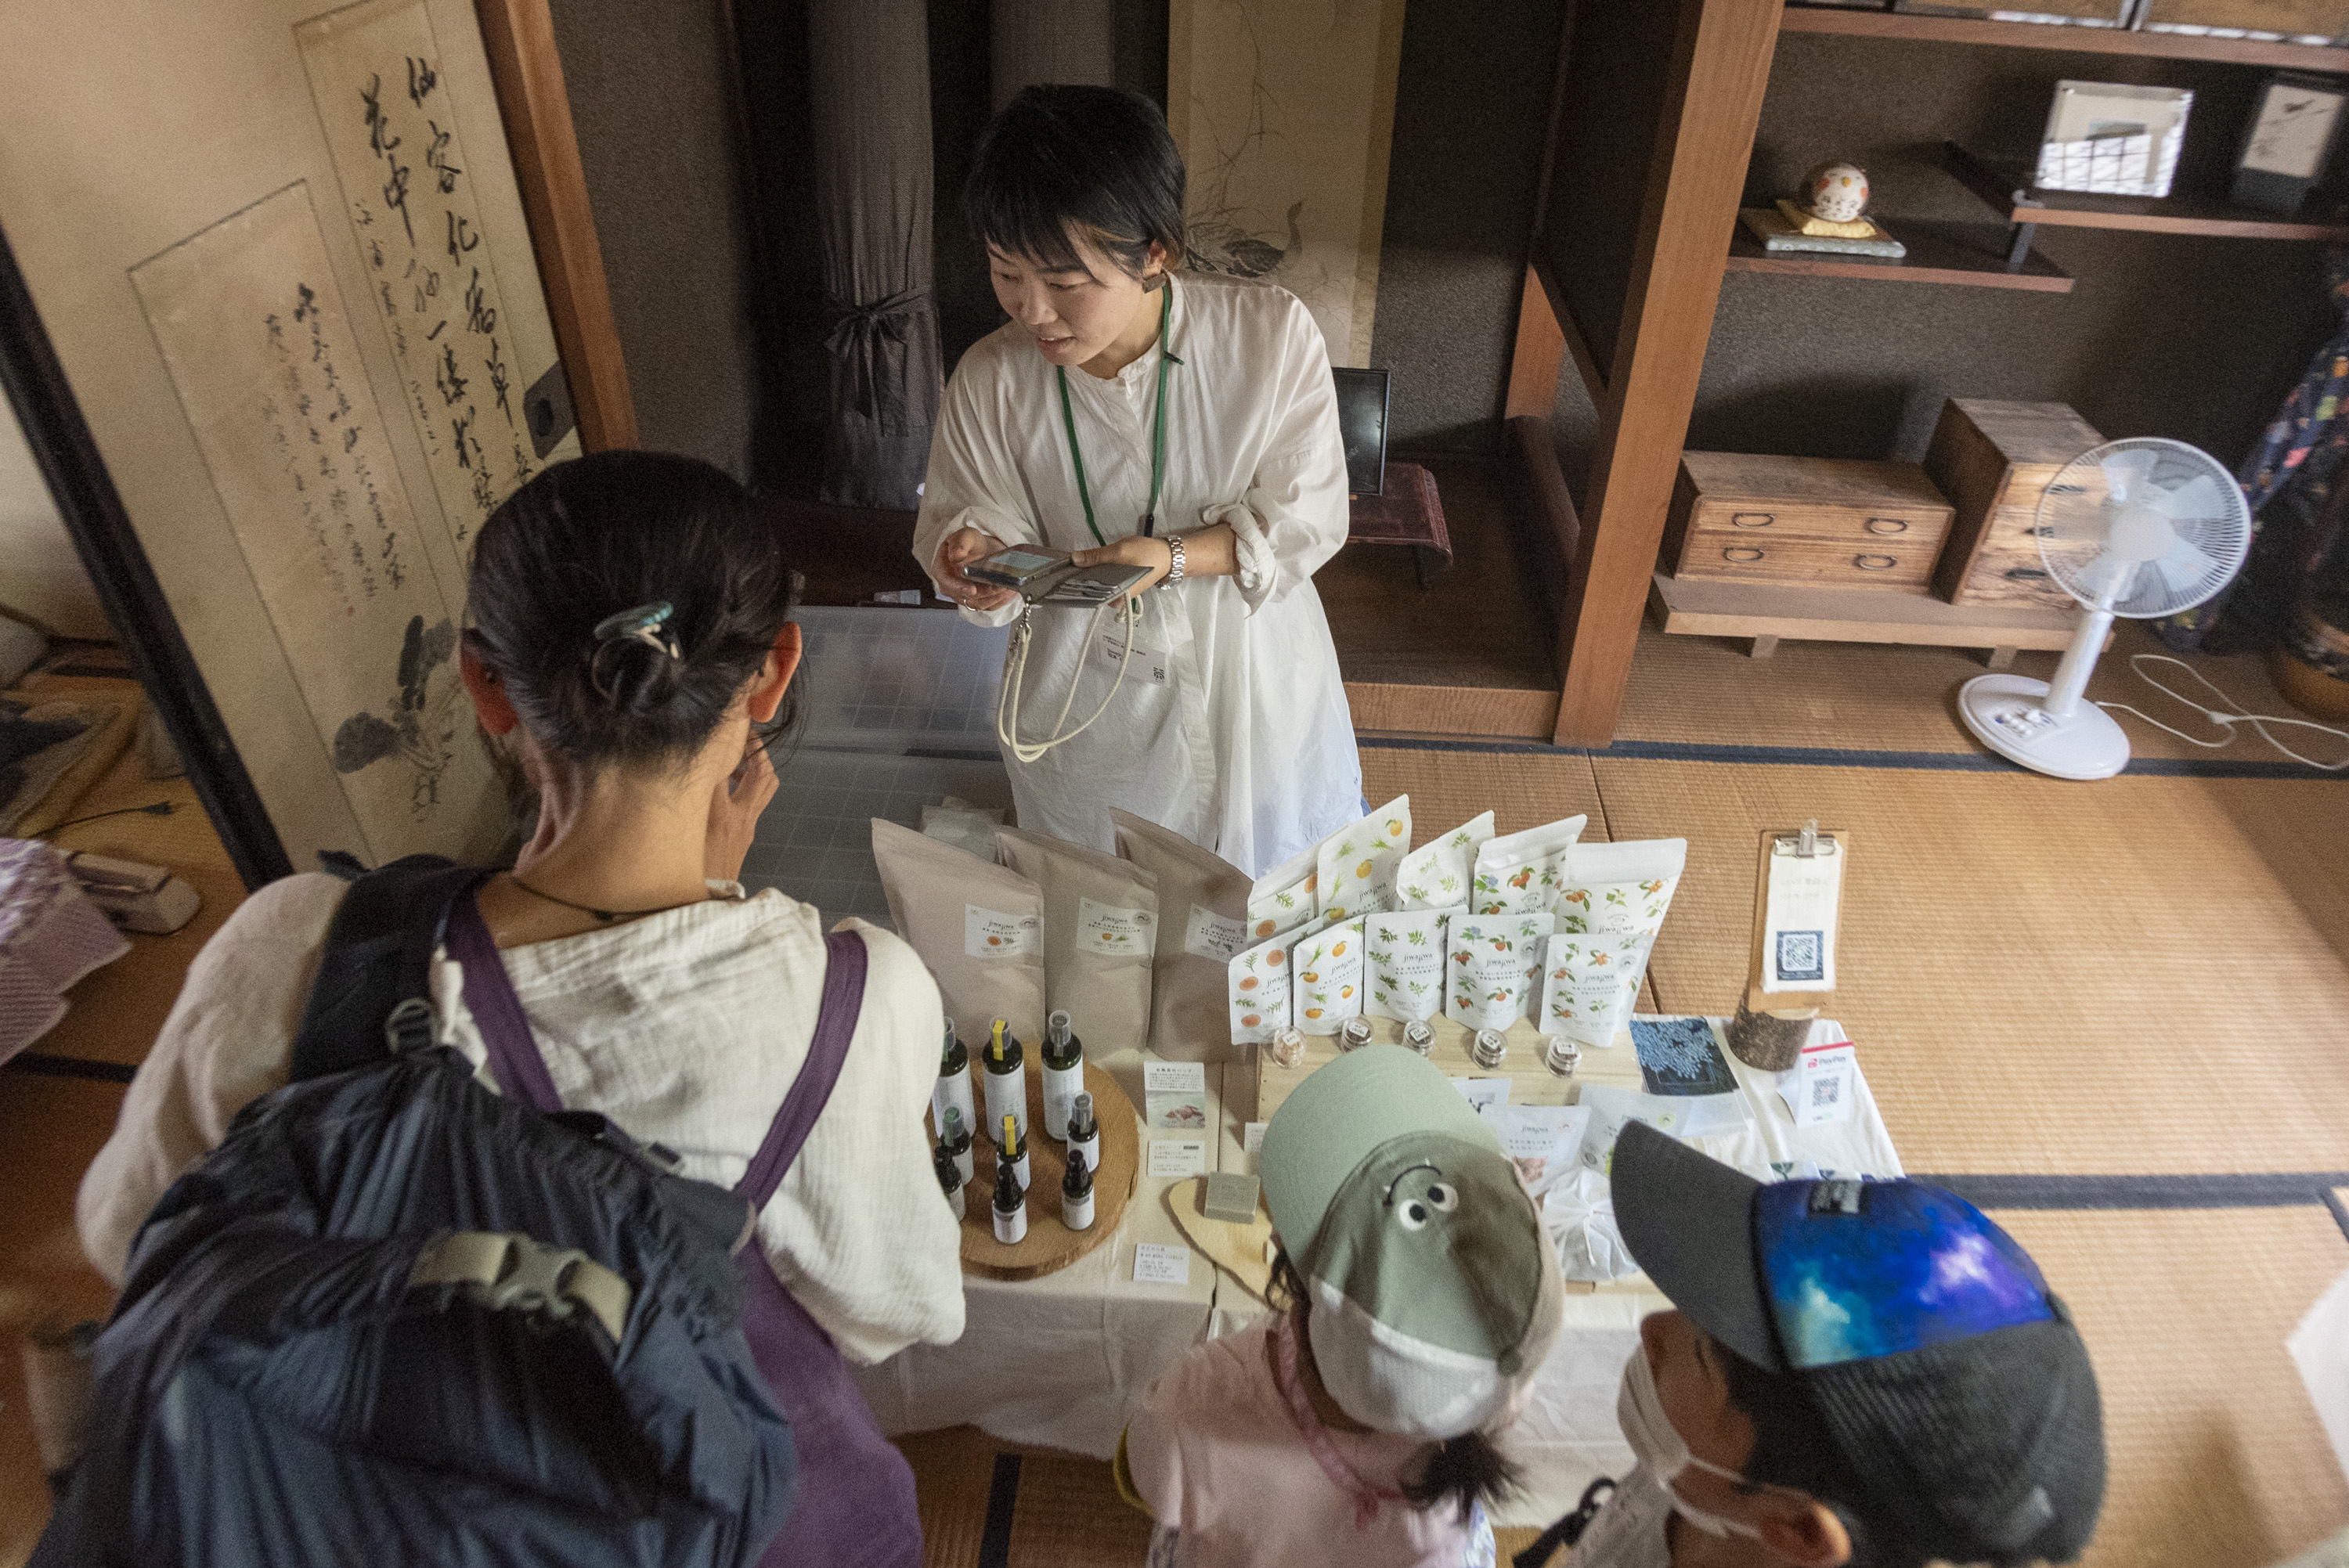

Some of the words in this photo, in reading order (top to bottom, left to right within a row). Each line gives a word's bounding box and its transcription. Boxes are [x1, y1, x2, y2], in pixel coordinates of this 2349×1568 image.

[988, 919, 1014, 930] jiwajiwa
[1101, 914, 1128, 925] jiwajiwa
[1210, 922, 1236, 933] jiwajiwa
[1403, 952, 1433, 964] jiwajiwa
[1486, 957, 1516, 968] jiwajiwa
[1331, 957, 1356, 974] jiwajiwa
[1584, 973, 1615, 984] jiwajiwa
